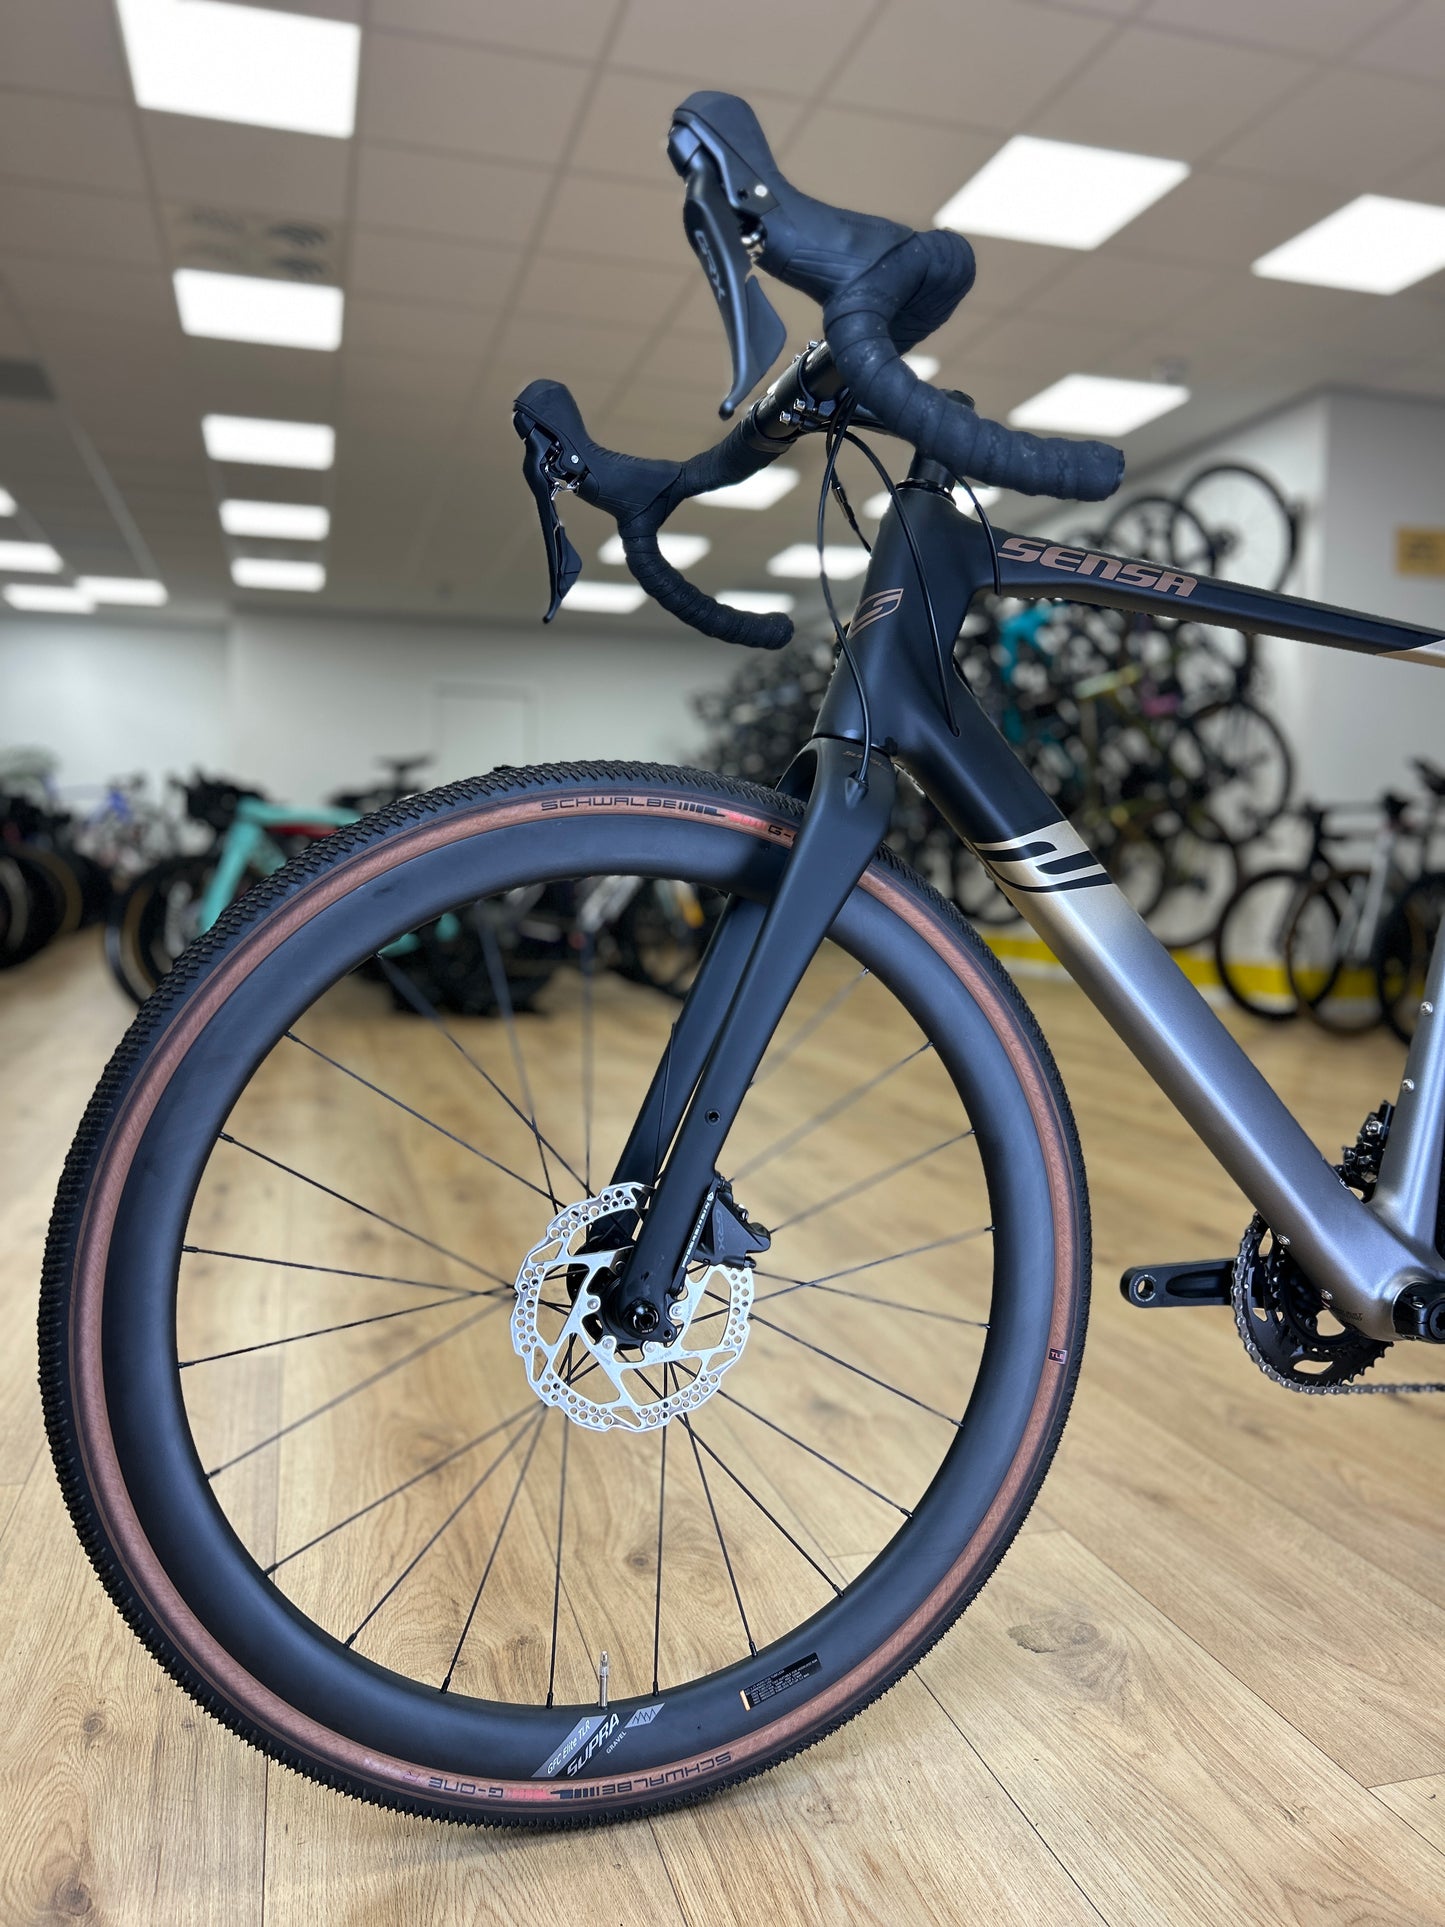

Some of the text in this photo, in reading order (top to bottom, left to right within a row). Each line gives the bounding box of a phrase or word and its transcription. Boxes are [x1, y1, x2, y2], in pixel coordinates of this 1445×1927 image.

[695, 230, 725, 300] GRX
[998, 538, 1198, 597] SENSA
[541, 796, 676, 811] SCHWALBE
[547, 1719, 591, 1774] GFC Elite TLR
[567, 1713, 620, 1777] SUPRA
[606, 1730, 627, 1754] GRAVEL
[428, 1776, 503, 1798] G-ONE
[603, 1751, 732, 1796] SCHWALBE
